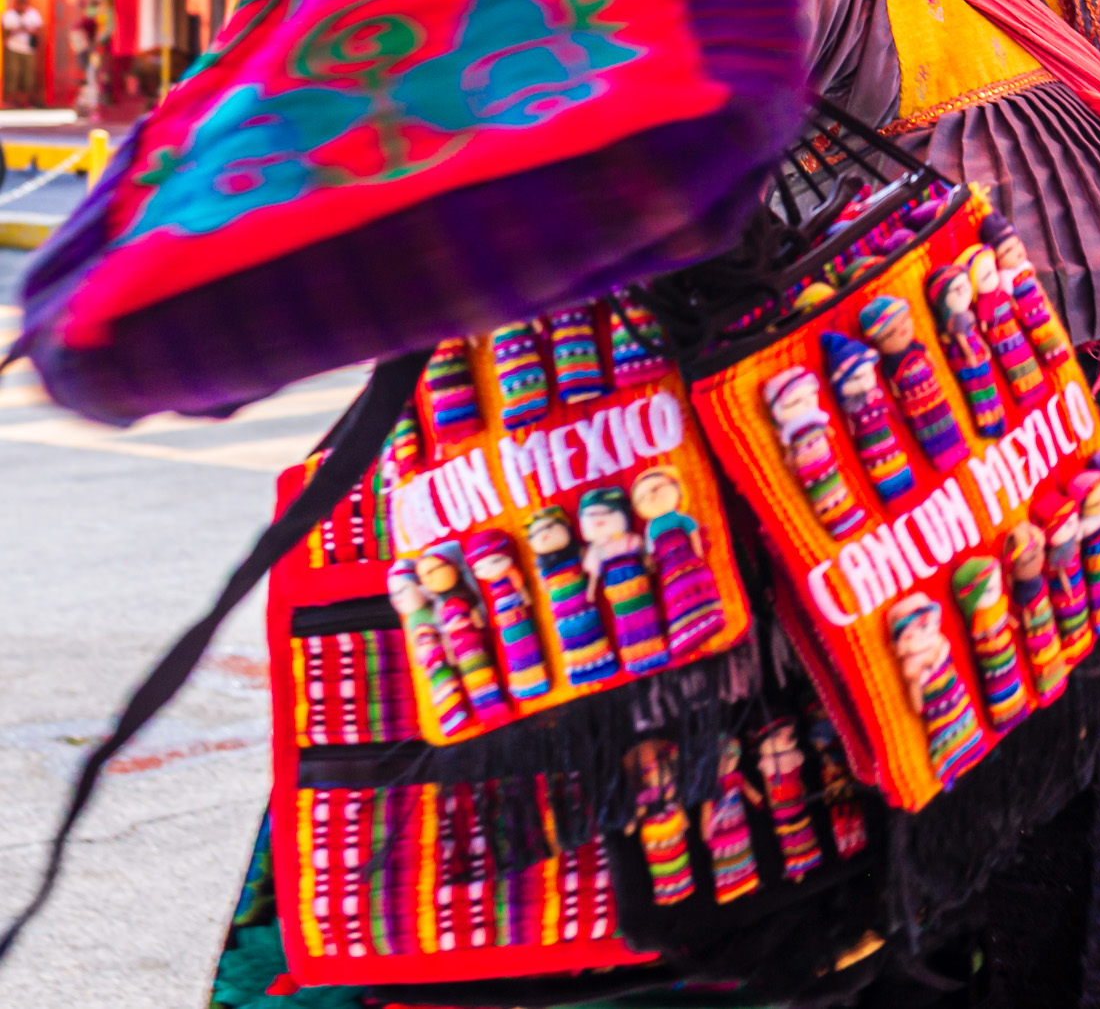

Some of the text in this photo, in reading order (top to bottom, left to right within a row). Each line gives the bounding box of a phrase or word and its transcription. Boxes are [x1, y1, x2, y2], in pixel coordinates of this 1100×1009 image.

[498, 391, 684, 509] MEXICO
[807, 380, 1094, 626] CANCUN MEXICO
